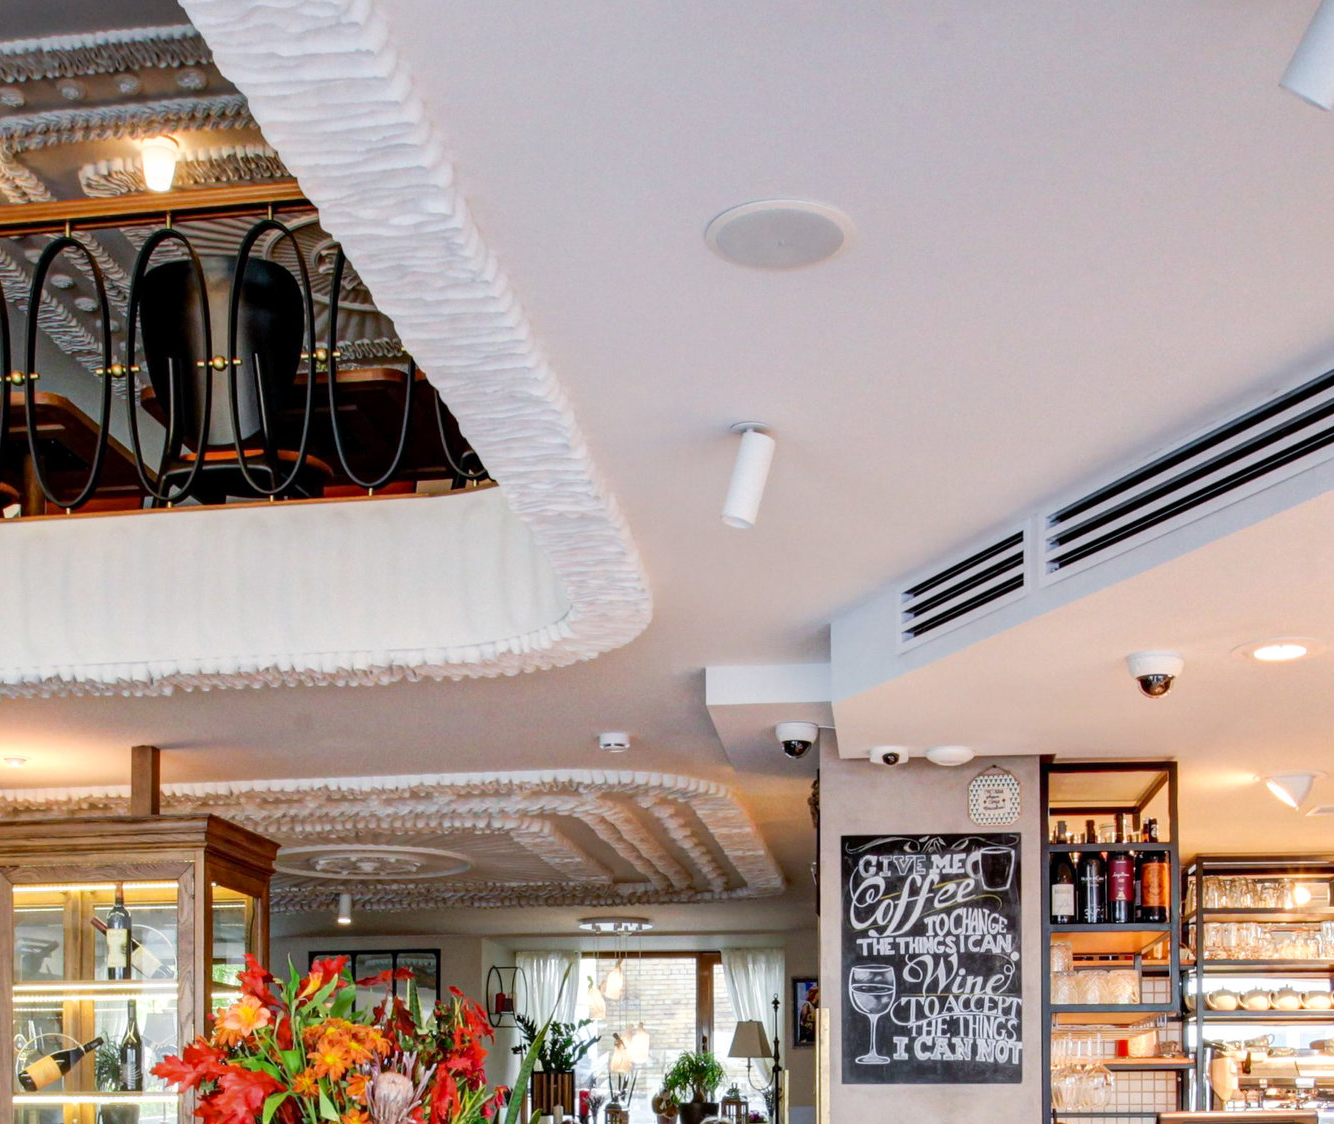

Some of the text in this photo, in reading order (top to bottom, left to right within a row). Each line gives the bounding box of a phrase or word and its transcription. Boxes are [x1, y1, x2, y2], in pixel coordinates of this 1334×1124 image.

[858, 853, 967, 878] GIVE ME
[850, 871, 976, 938] Coffee
[924, 907, 1008, 936] TO CHANGE
[856, 936, 895, 956] THE
[896, 935, 957, 955] THINGS
[959, 935, 965, 953] I
[903, 952, 1014, 996] Wine
[898, 995, 1022, 1023] TO ACCEPT
[908, 1014, 1018, 1041] THE THINGS
[892, 1036, 909, 1060] I
